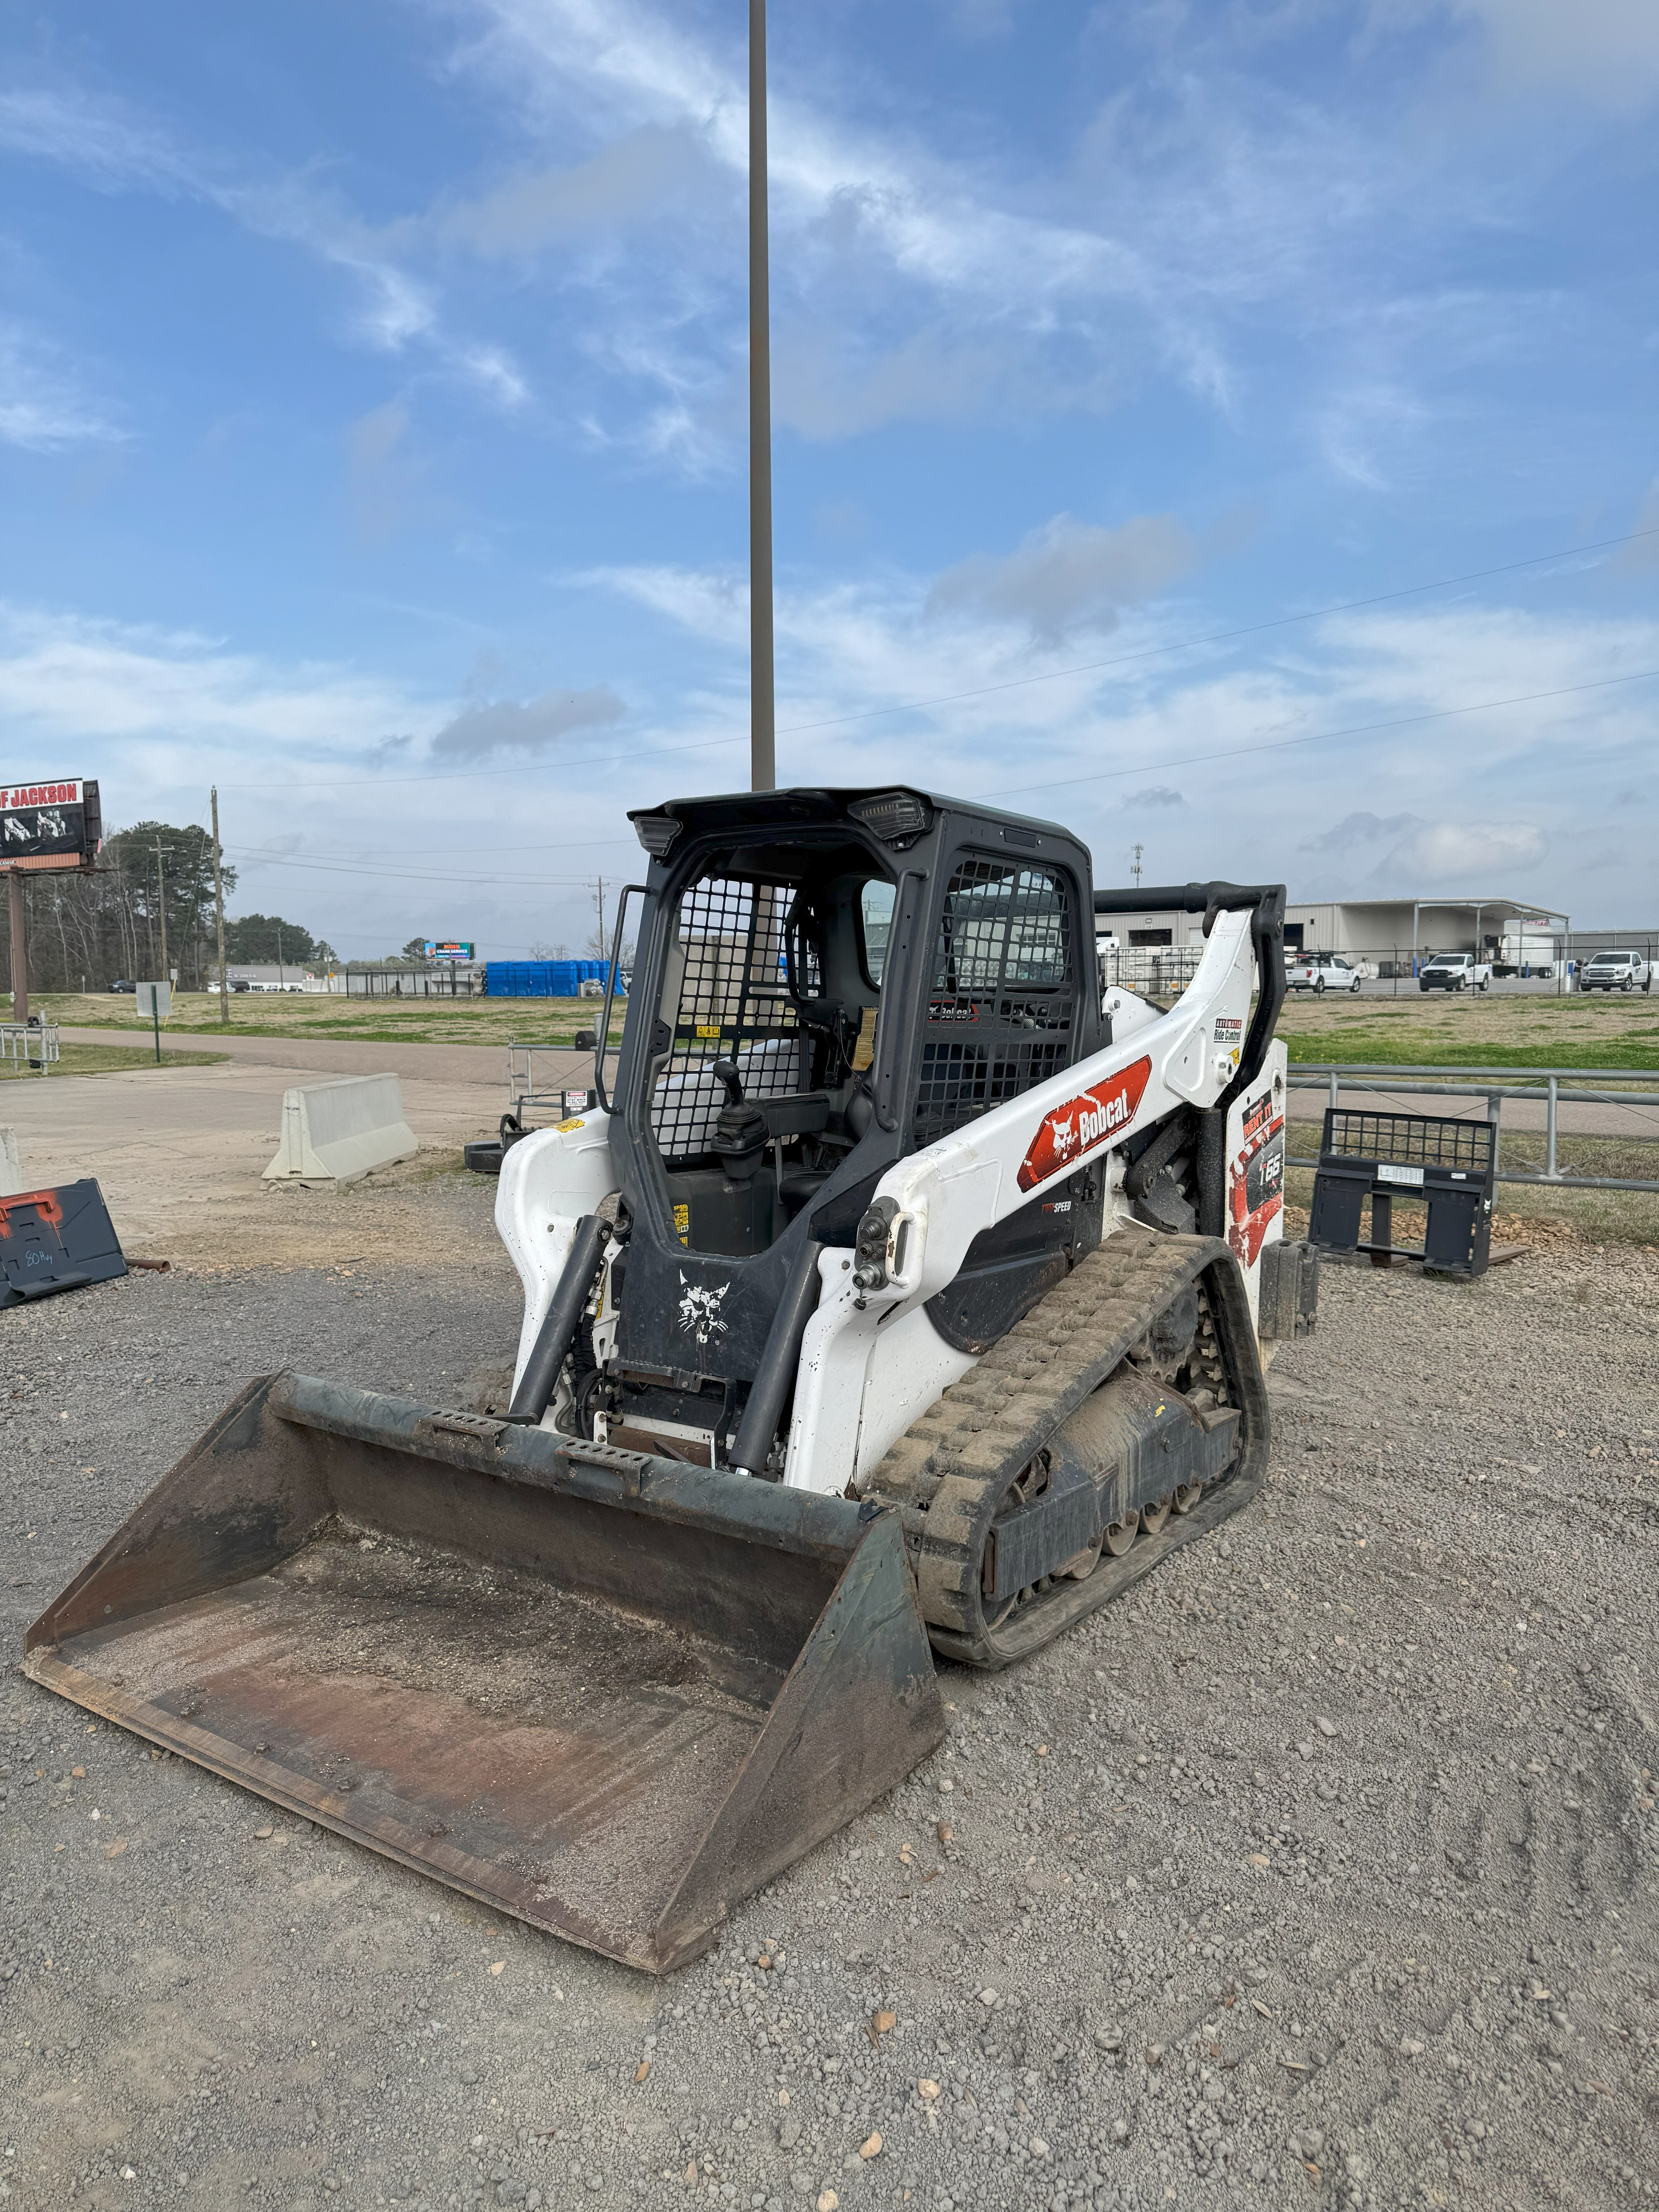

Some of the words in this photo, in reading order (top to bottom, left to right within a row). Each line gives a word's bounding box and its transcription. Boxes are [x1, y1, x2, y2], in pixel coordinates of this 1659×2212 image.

[0, 791, 8, 809] F
[10, 783, 77, 807] JACKSON
[1216, 1020, 1241, 1028] AUTOMATIC
[1214, 1029, 1224, 1040] Ride
[1225, 1029, 1241, 1041] Control
[1079, 1088, 1128, 1146] Bobcat
[1243, 1109, 1263, 1139] RENT
[1264, 1102, 1272, 1120] IT
[1259, 1153, 1281, 1186] T66
[1054, 1201, 1071, 1213] SPEED
[26, 1250, 40, 1267] 80
